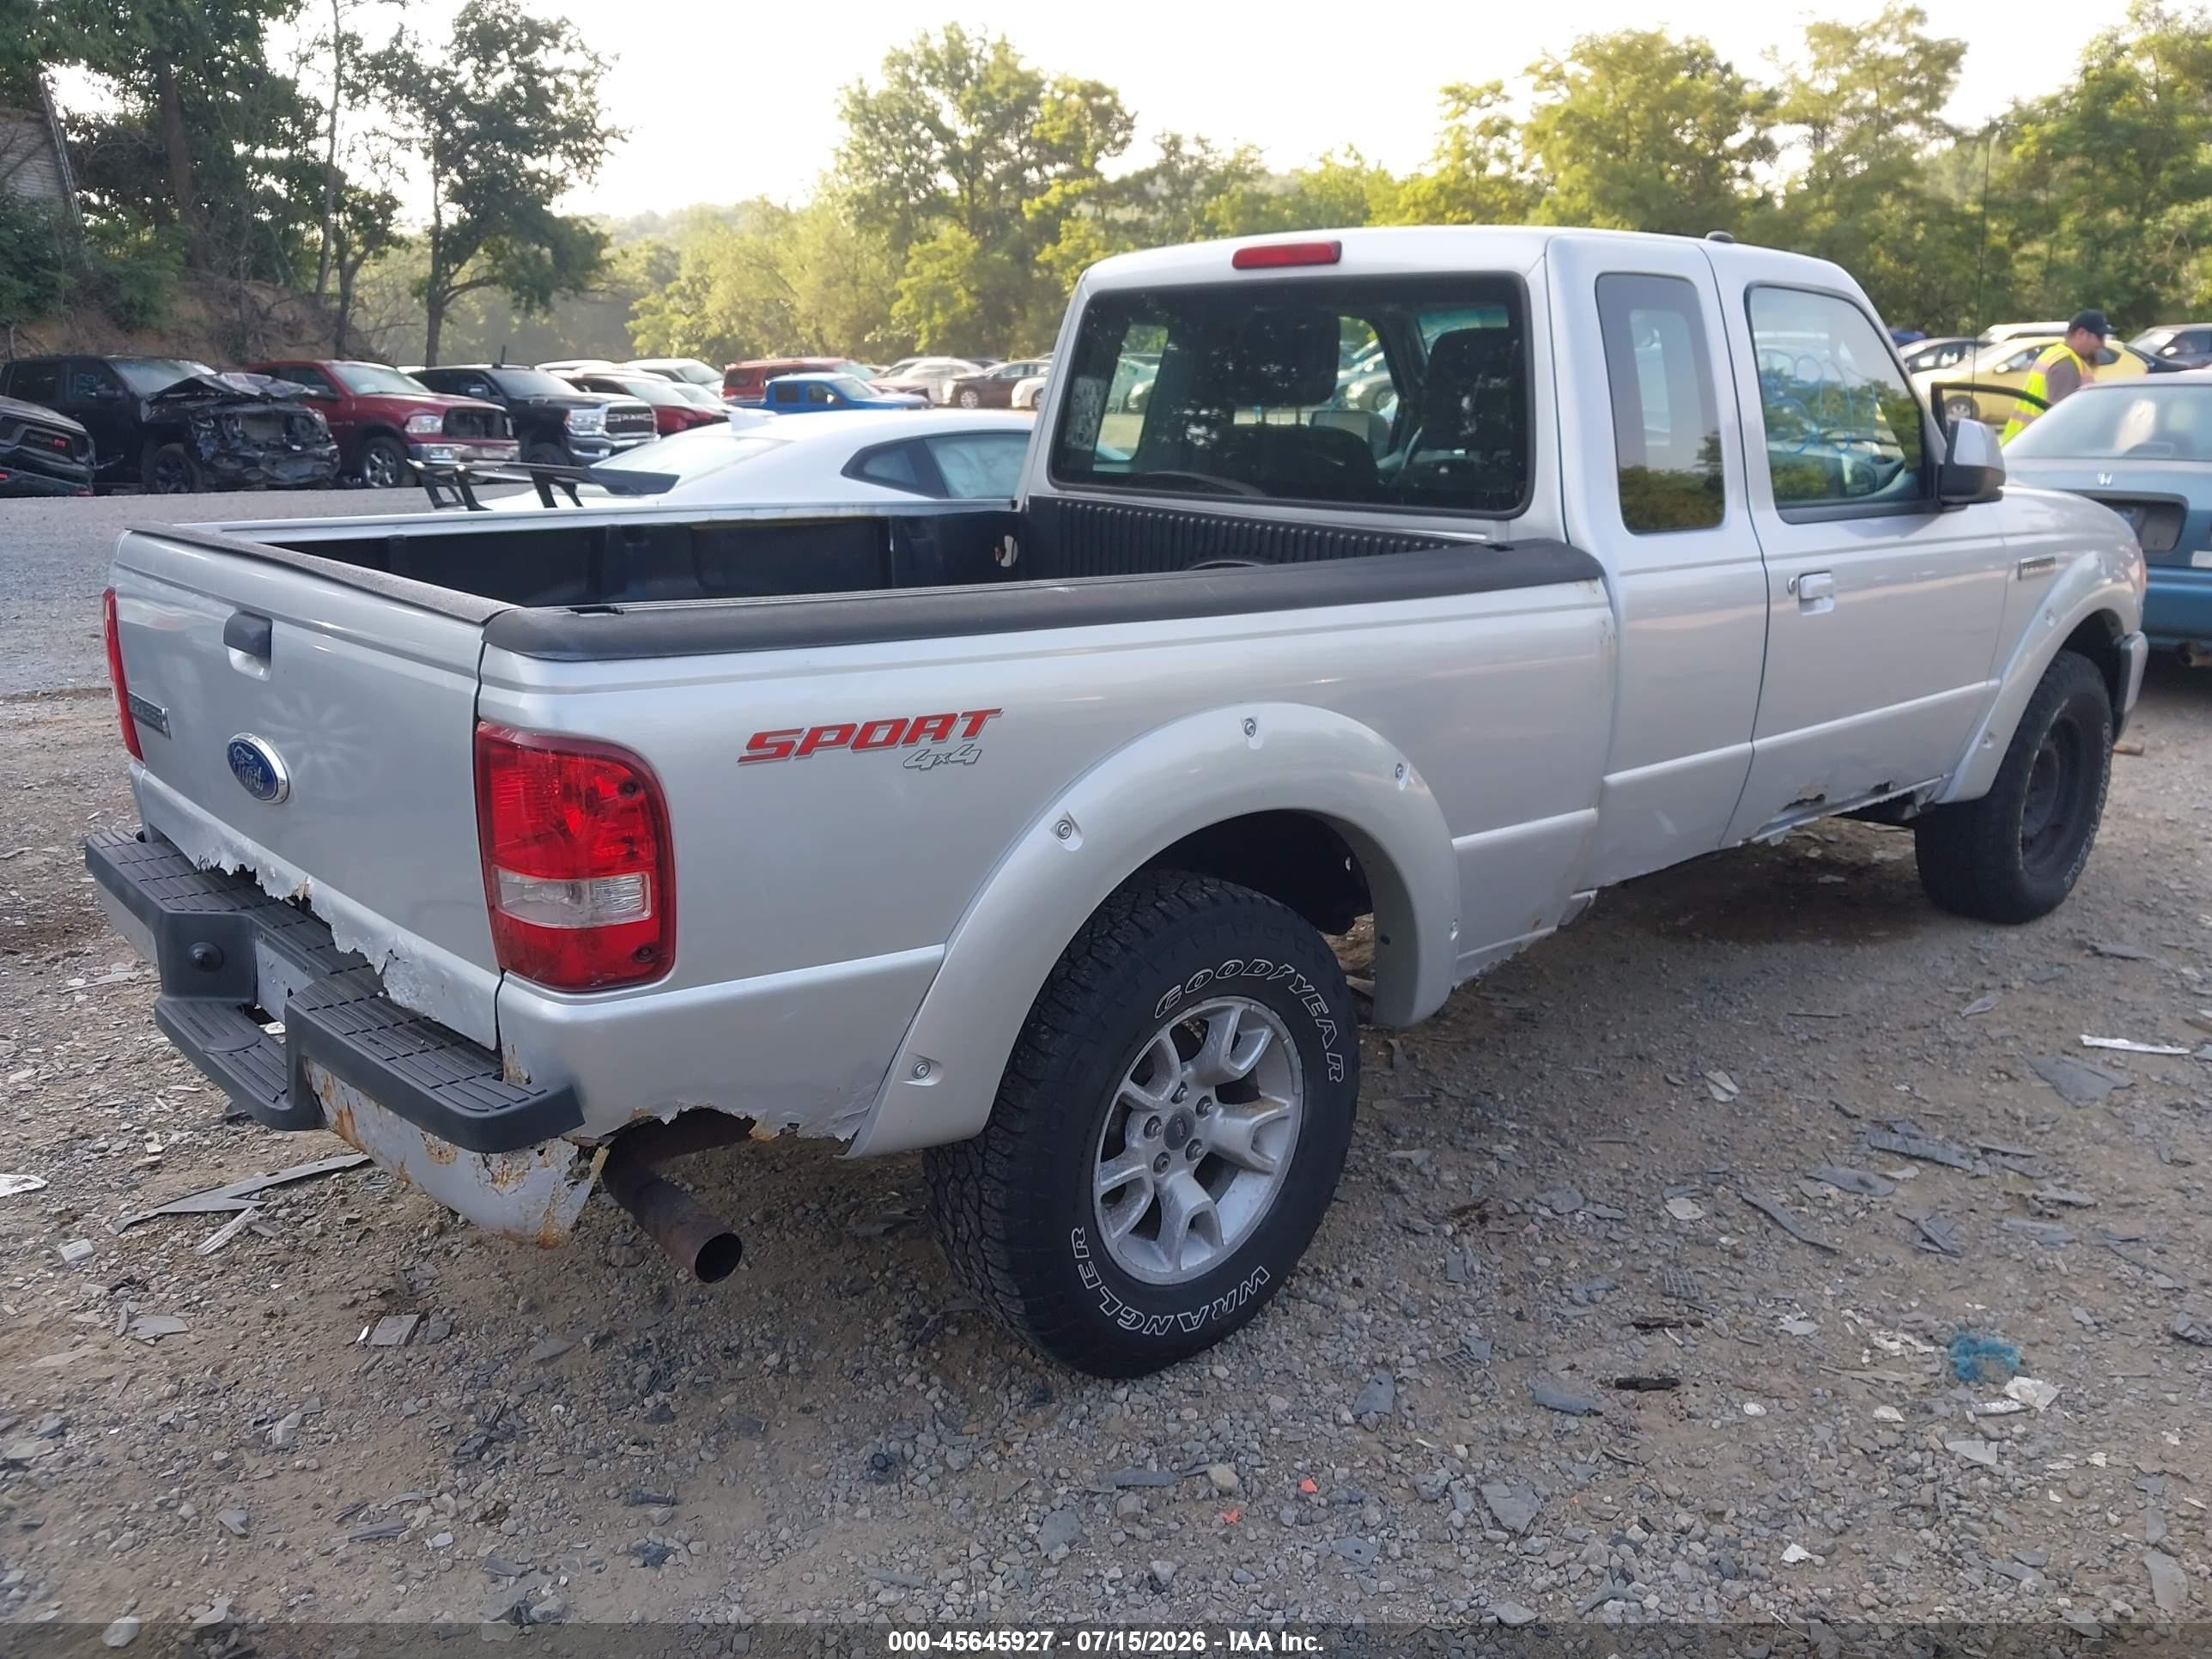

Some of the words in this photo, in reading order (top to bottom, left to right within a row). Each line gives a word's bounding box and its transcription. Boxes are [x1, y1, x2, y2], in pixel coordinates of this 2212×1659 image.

[736, 708, 1003, 764] SPORT
[902, 743, 982, 770] 4x4
[232, 744, 264, 792] Ford
[1154, 958, 1345, 1083] GOODYEAR
[1071, 1226, 1271, 1336] WRANGLER
